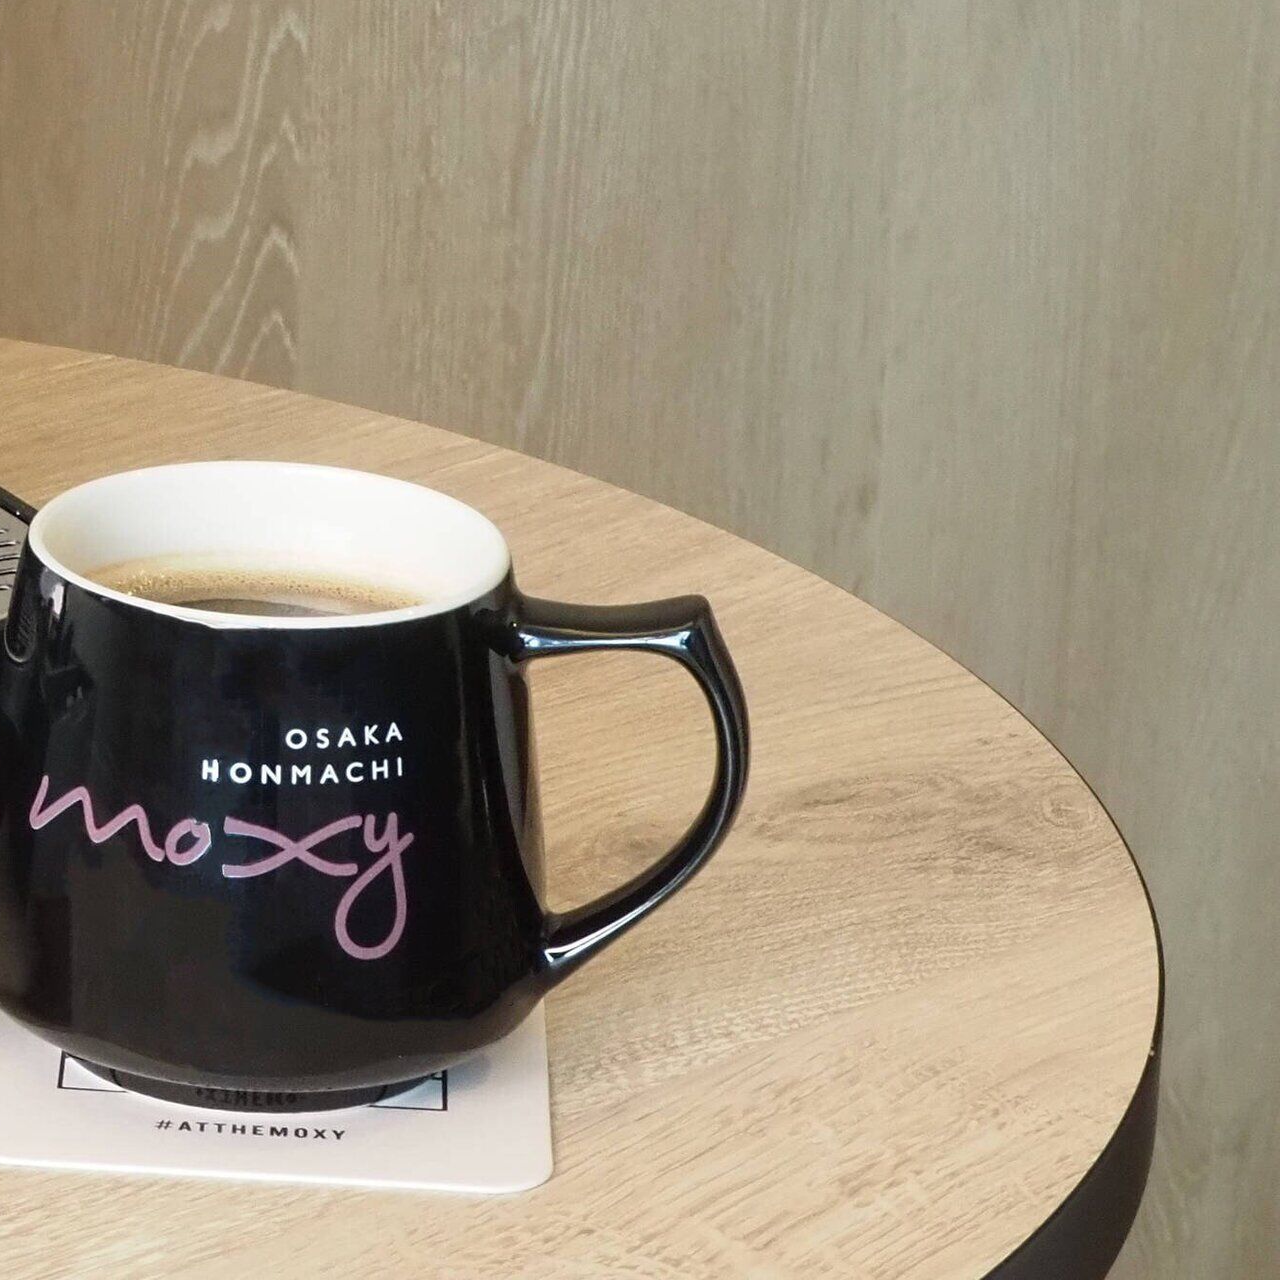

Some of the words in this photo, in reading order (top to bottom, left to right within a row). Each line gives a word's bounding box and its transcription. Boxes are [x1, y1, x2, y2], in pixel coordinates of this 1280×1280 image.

[285, 722, 403, 750] OSAKA
[201, 756, 404, 785] HONMACHI
[29, 775, 415, 960] moxy
[155, 1120, 346, 1141] #ATTHEMOXY
